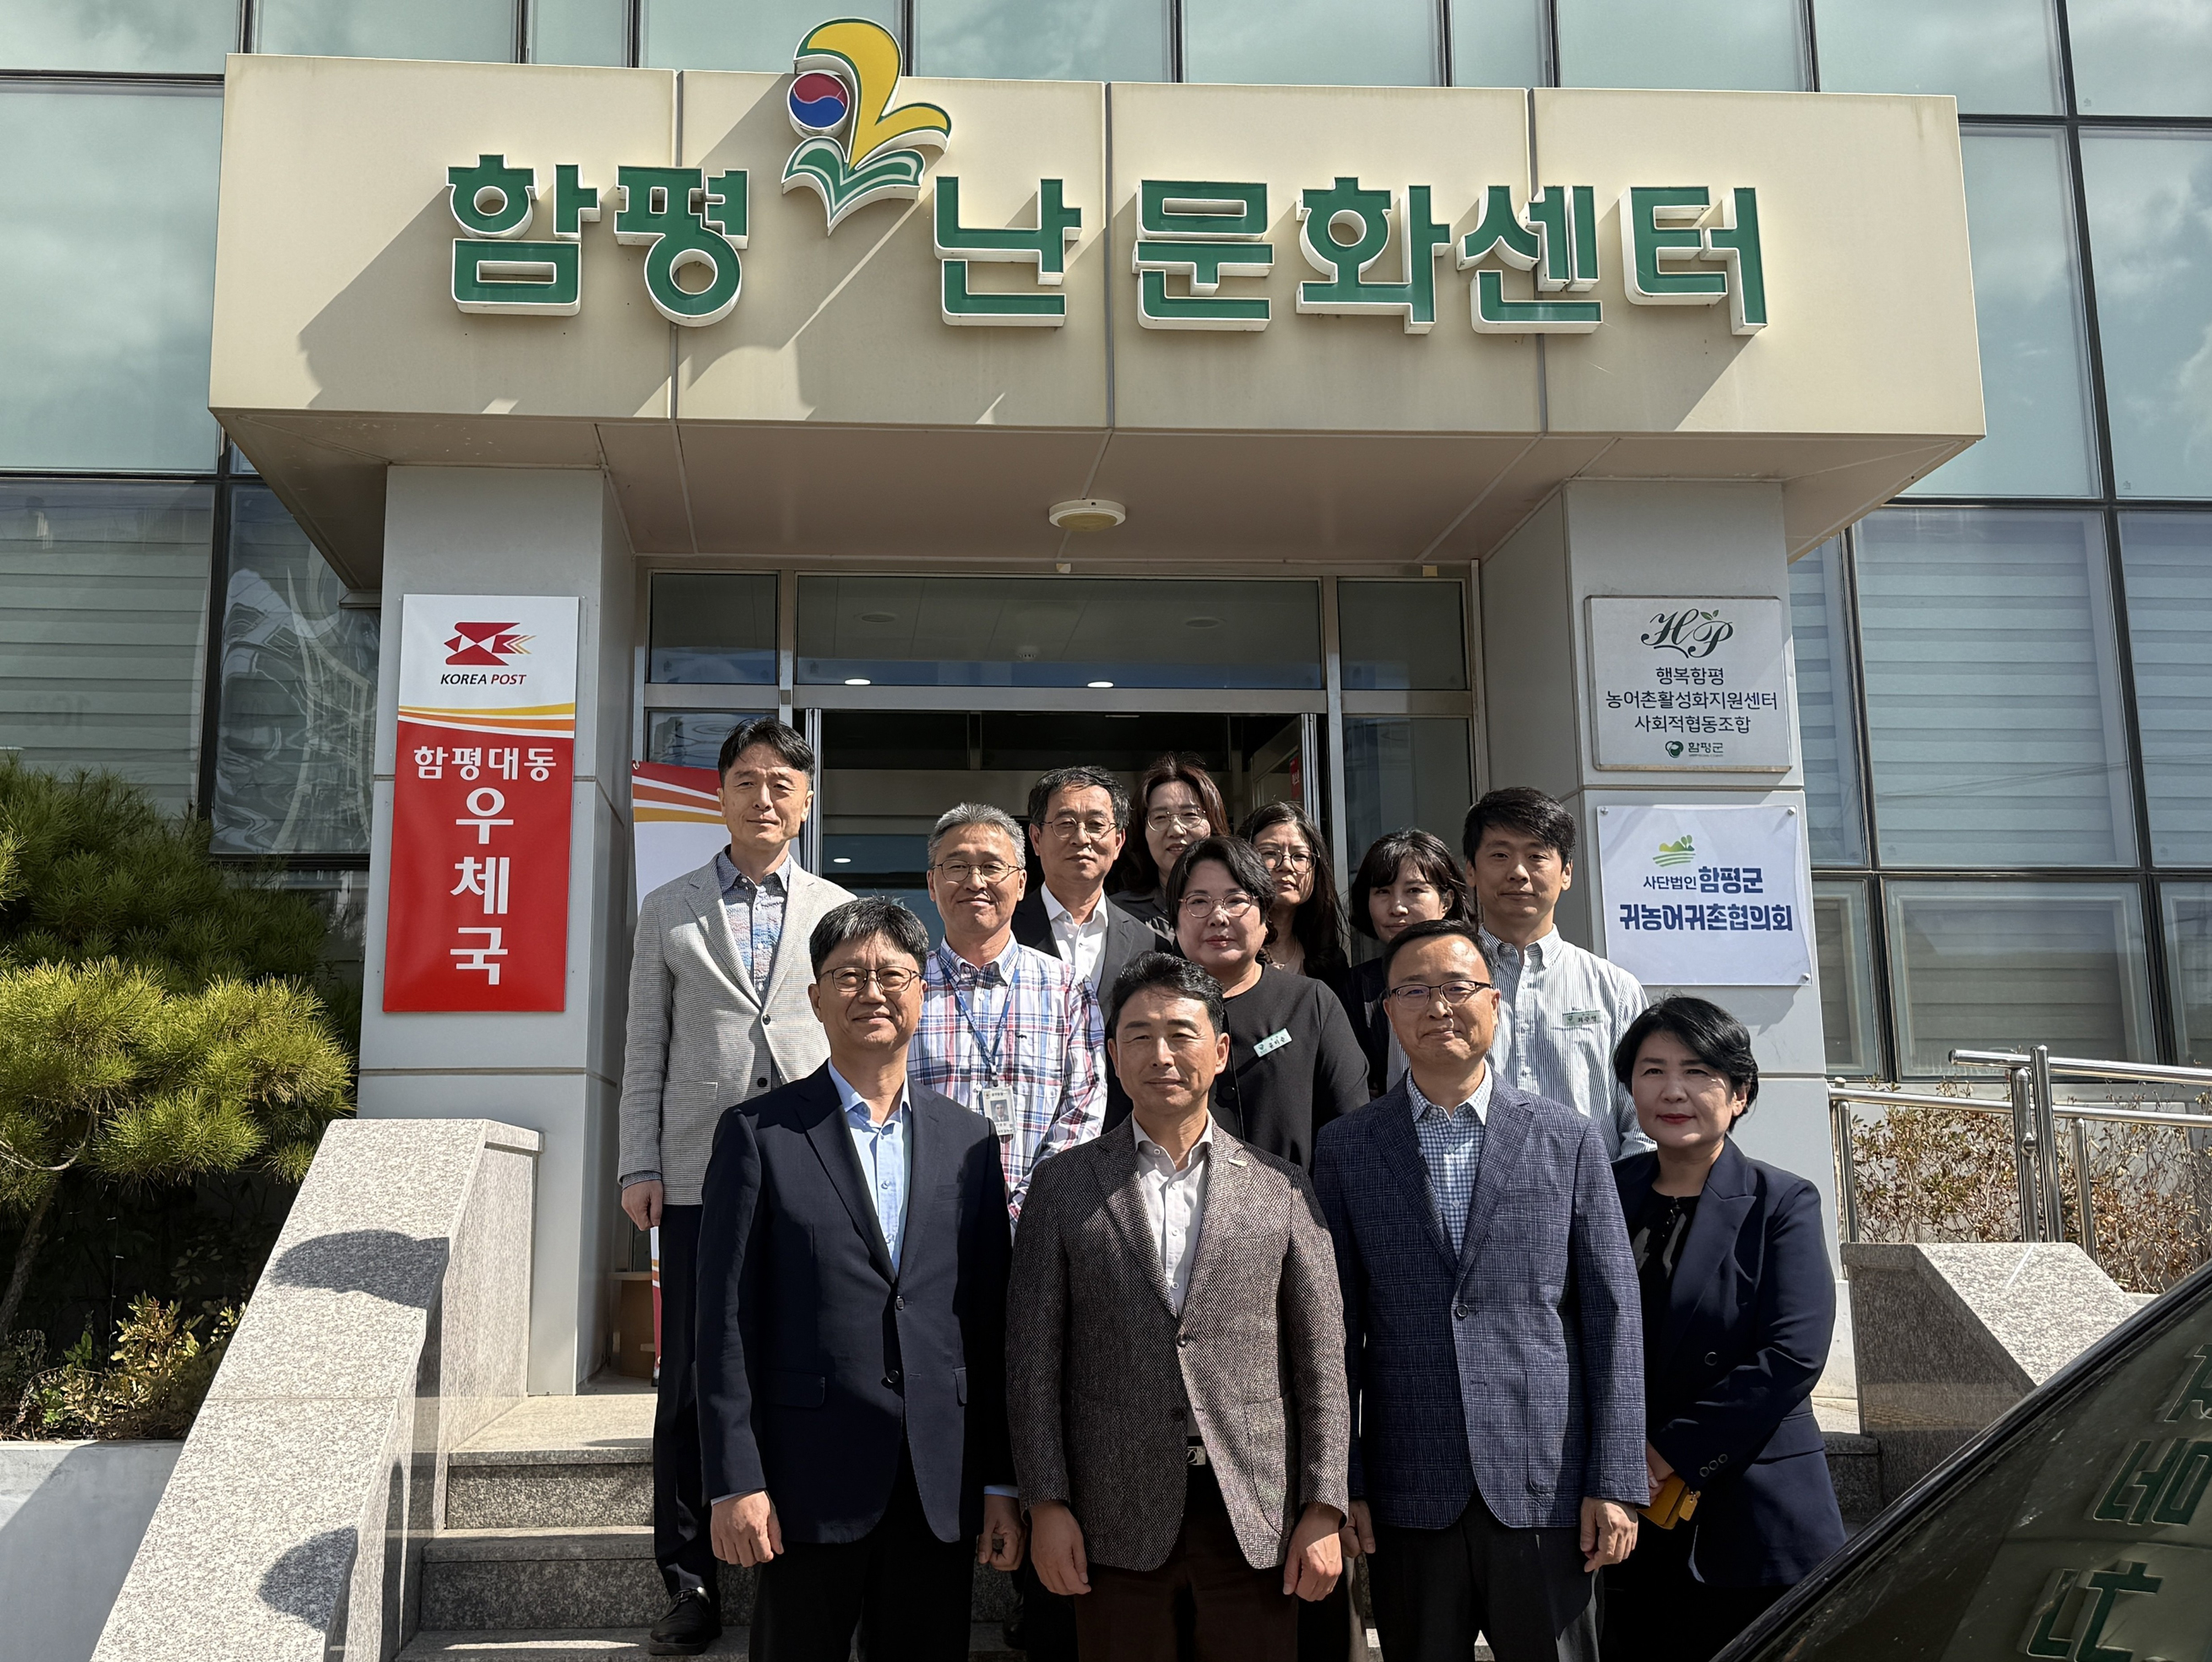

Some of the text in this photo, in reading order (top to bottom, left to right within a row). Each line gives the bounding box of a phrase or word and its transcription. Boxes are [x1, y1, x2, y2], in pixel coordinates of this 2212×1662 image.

[447, 154, 1769, 336] 함평 난 문화센터
[440, 674, 527, 685] KOREA POST
[1656, 666, 1725, 686] 행복함평
[1605, 690, 1778, 711] 농어촌활성화지원센터
[1635, 714, 1751, 734] 사회적협동조합
[1688, 741, 1724, 754] 함평군
[413, 745, 557, 782] 함평대동
[449, 786, 514, 987] 우체국
[1643, 865, 1764, 894] 사단법인 함평군
[1618, 902, 1794, 932] 귀농어귀촌협의회
